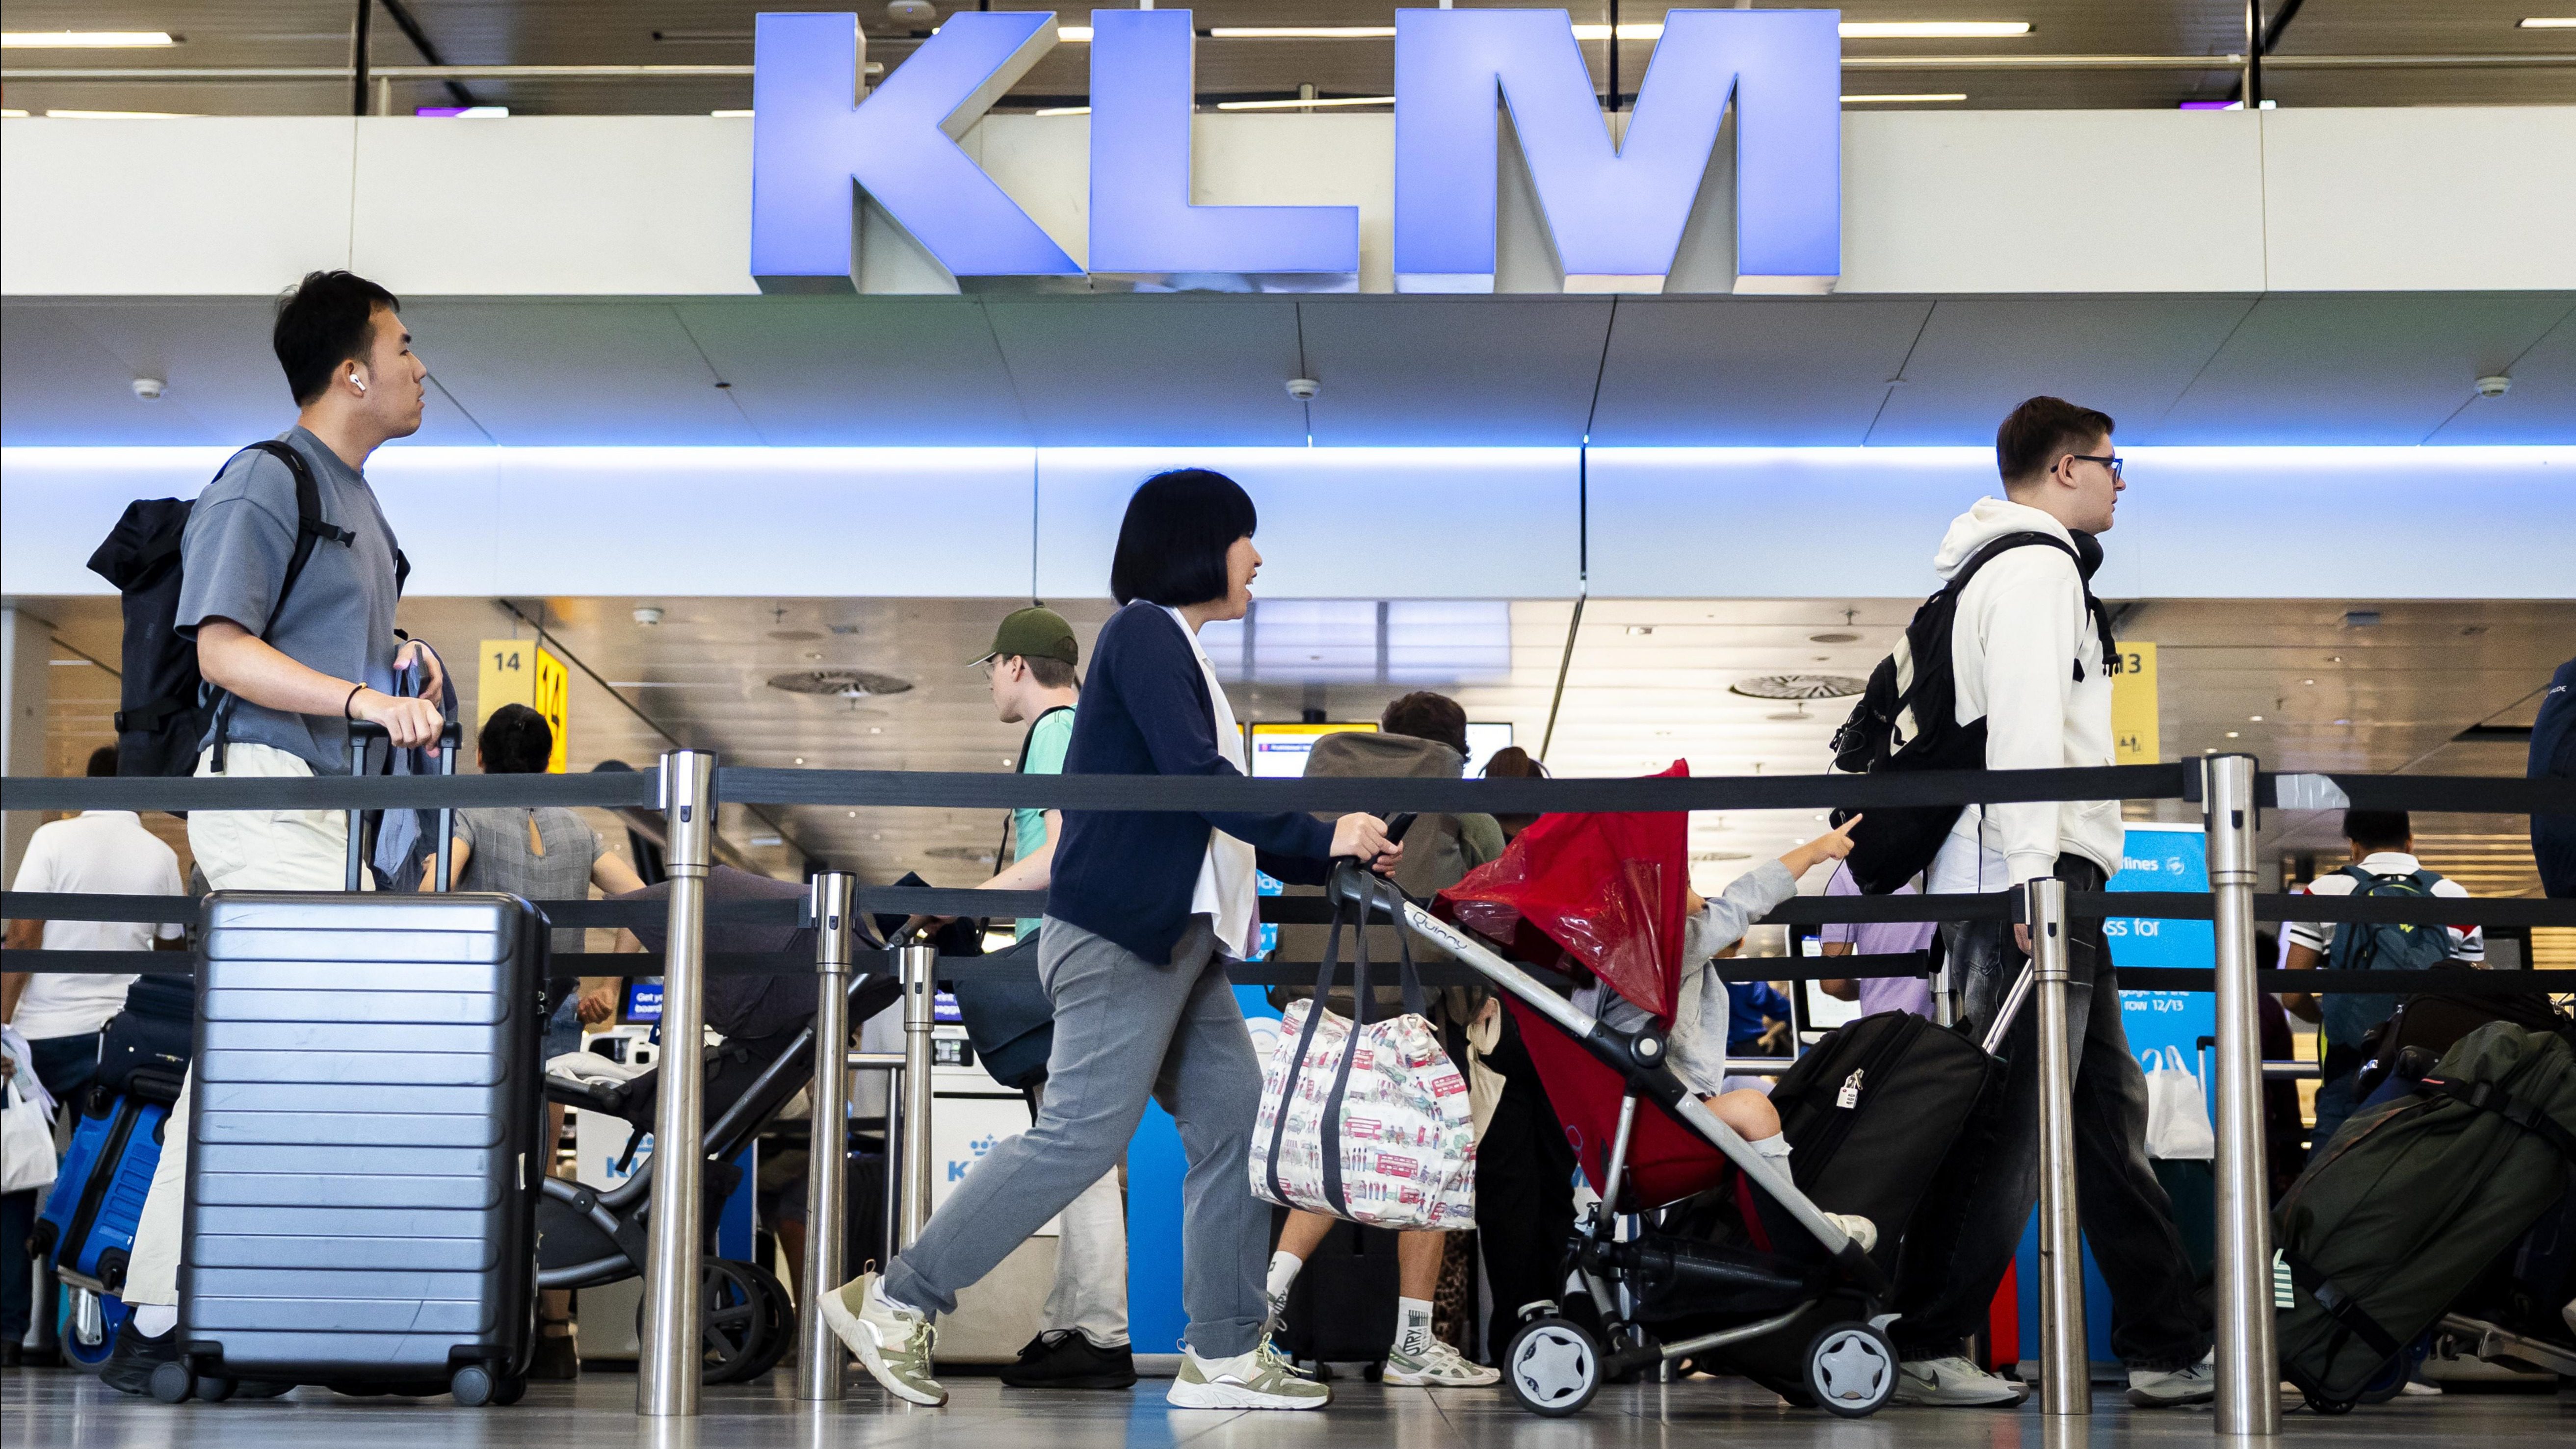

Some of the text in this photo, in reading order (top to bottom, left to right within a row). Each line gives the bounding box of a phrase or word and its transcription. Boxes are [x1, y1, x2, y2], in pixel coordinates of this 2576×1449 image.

[751, 8, 1842, 290] KLM
[494, 652, 521, 671] 14
[1413, 911, 1468, 950] Quinny
